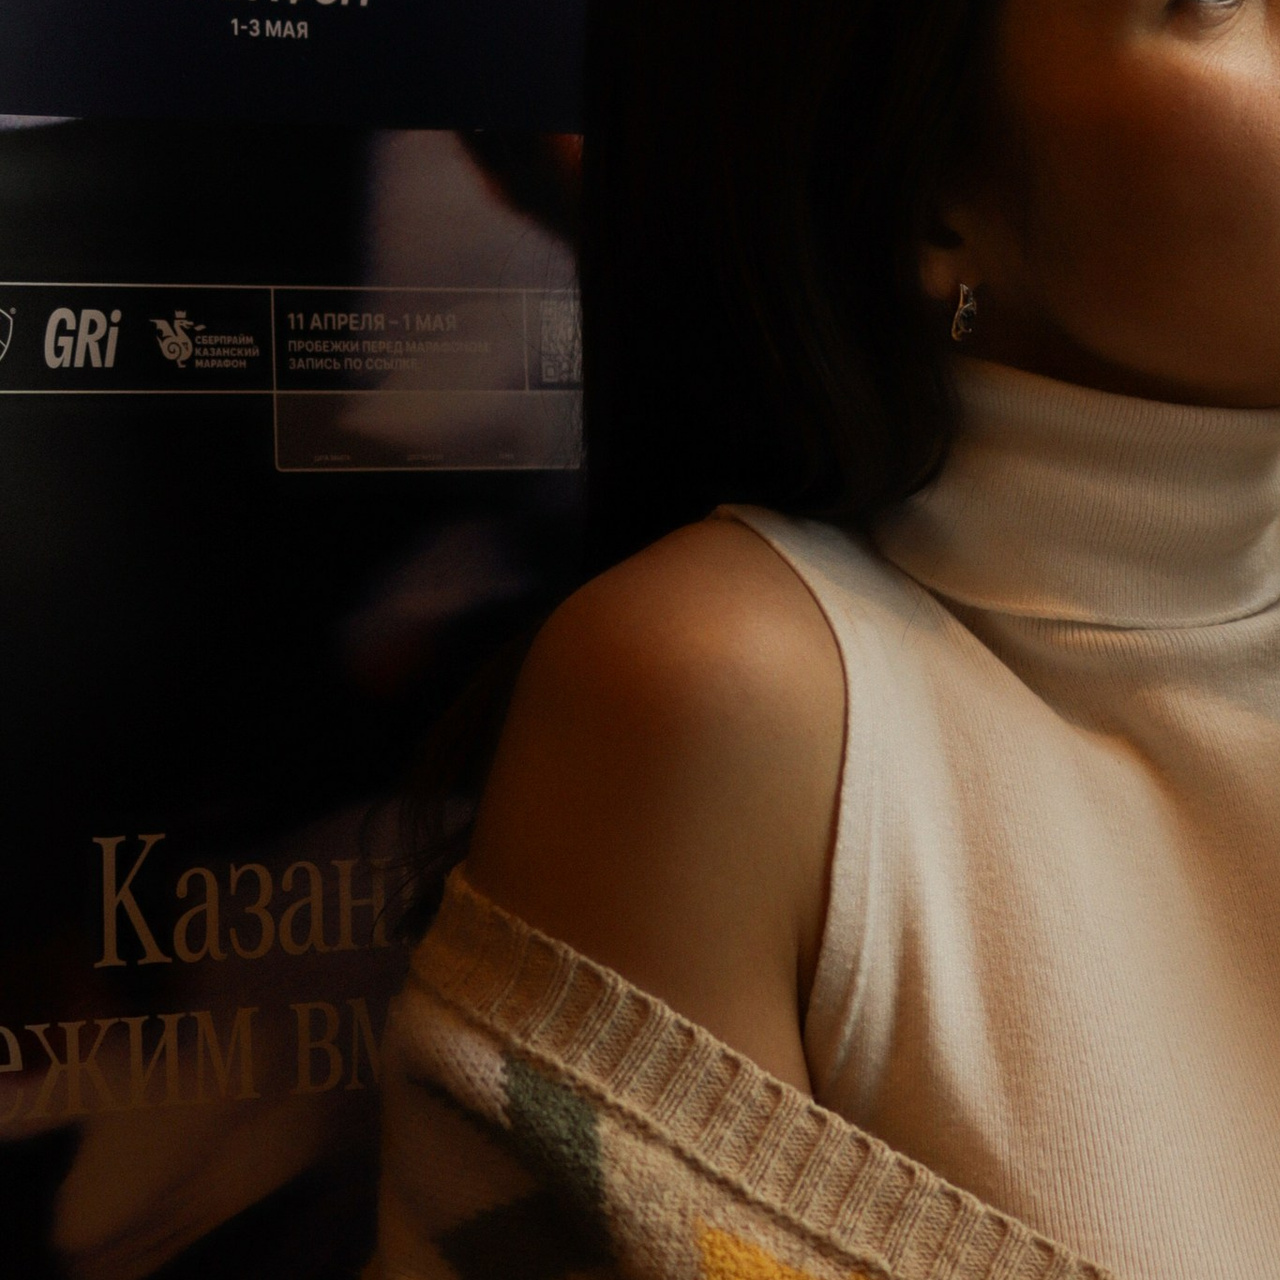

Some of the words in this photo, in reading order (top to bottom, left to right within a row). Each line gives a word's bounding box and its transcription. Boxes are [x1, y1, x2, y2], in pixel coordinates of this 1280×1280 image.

[230, 18, 261, 37] 1-3
[265, 20, 308, 39] МАЯ
[287, 313, 304, 330] 11
[309, 312, 385, 331] АПРЕЛЯ
[403, 313, 410, 331] 1
[416, 313, 457, 331] МАЯ
[195, 333, 254, 345] СБЕРПРАЙМ
[195, 346, 259, 357] КАЗАНСКИЙ
[288, 340, 359, 352] ПРОБЕЖКИ
[362, 340, 403, 353] ПЕРЕД
[195, 359, 247, 369] МАРАФОН
[288, 357, 341, 370] ЗАПИСЬ
[344, 358, 362, 369] ПО
